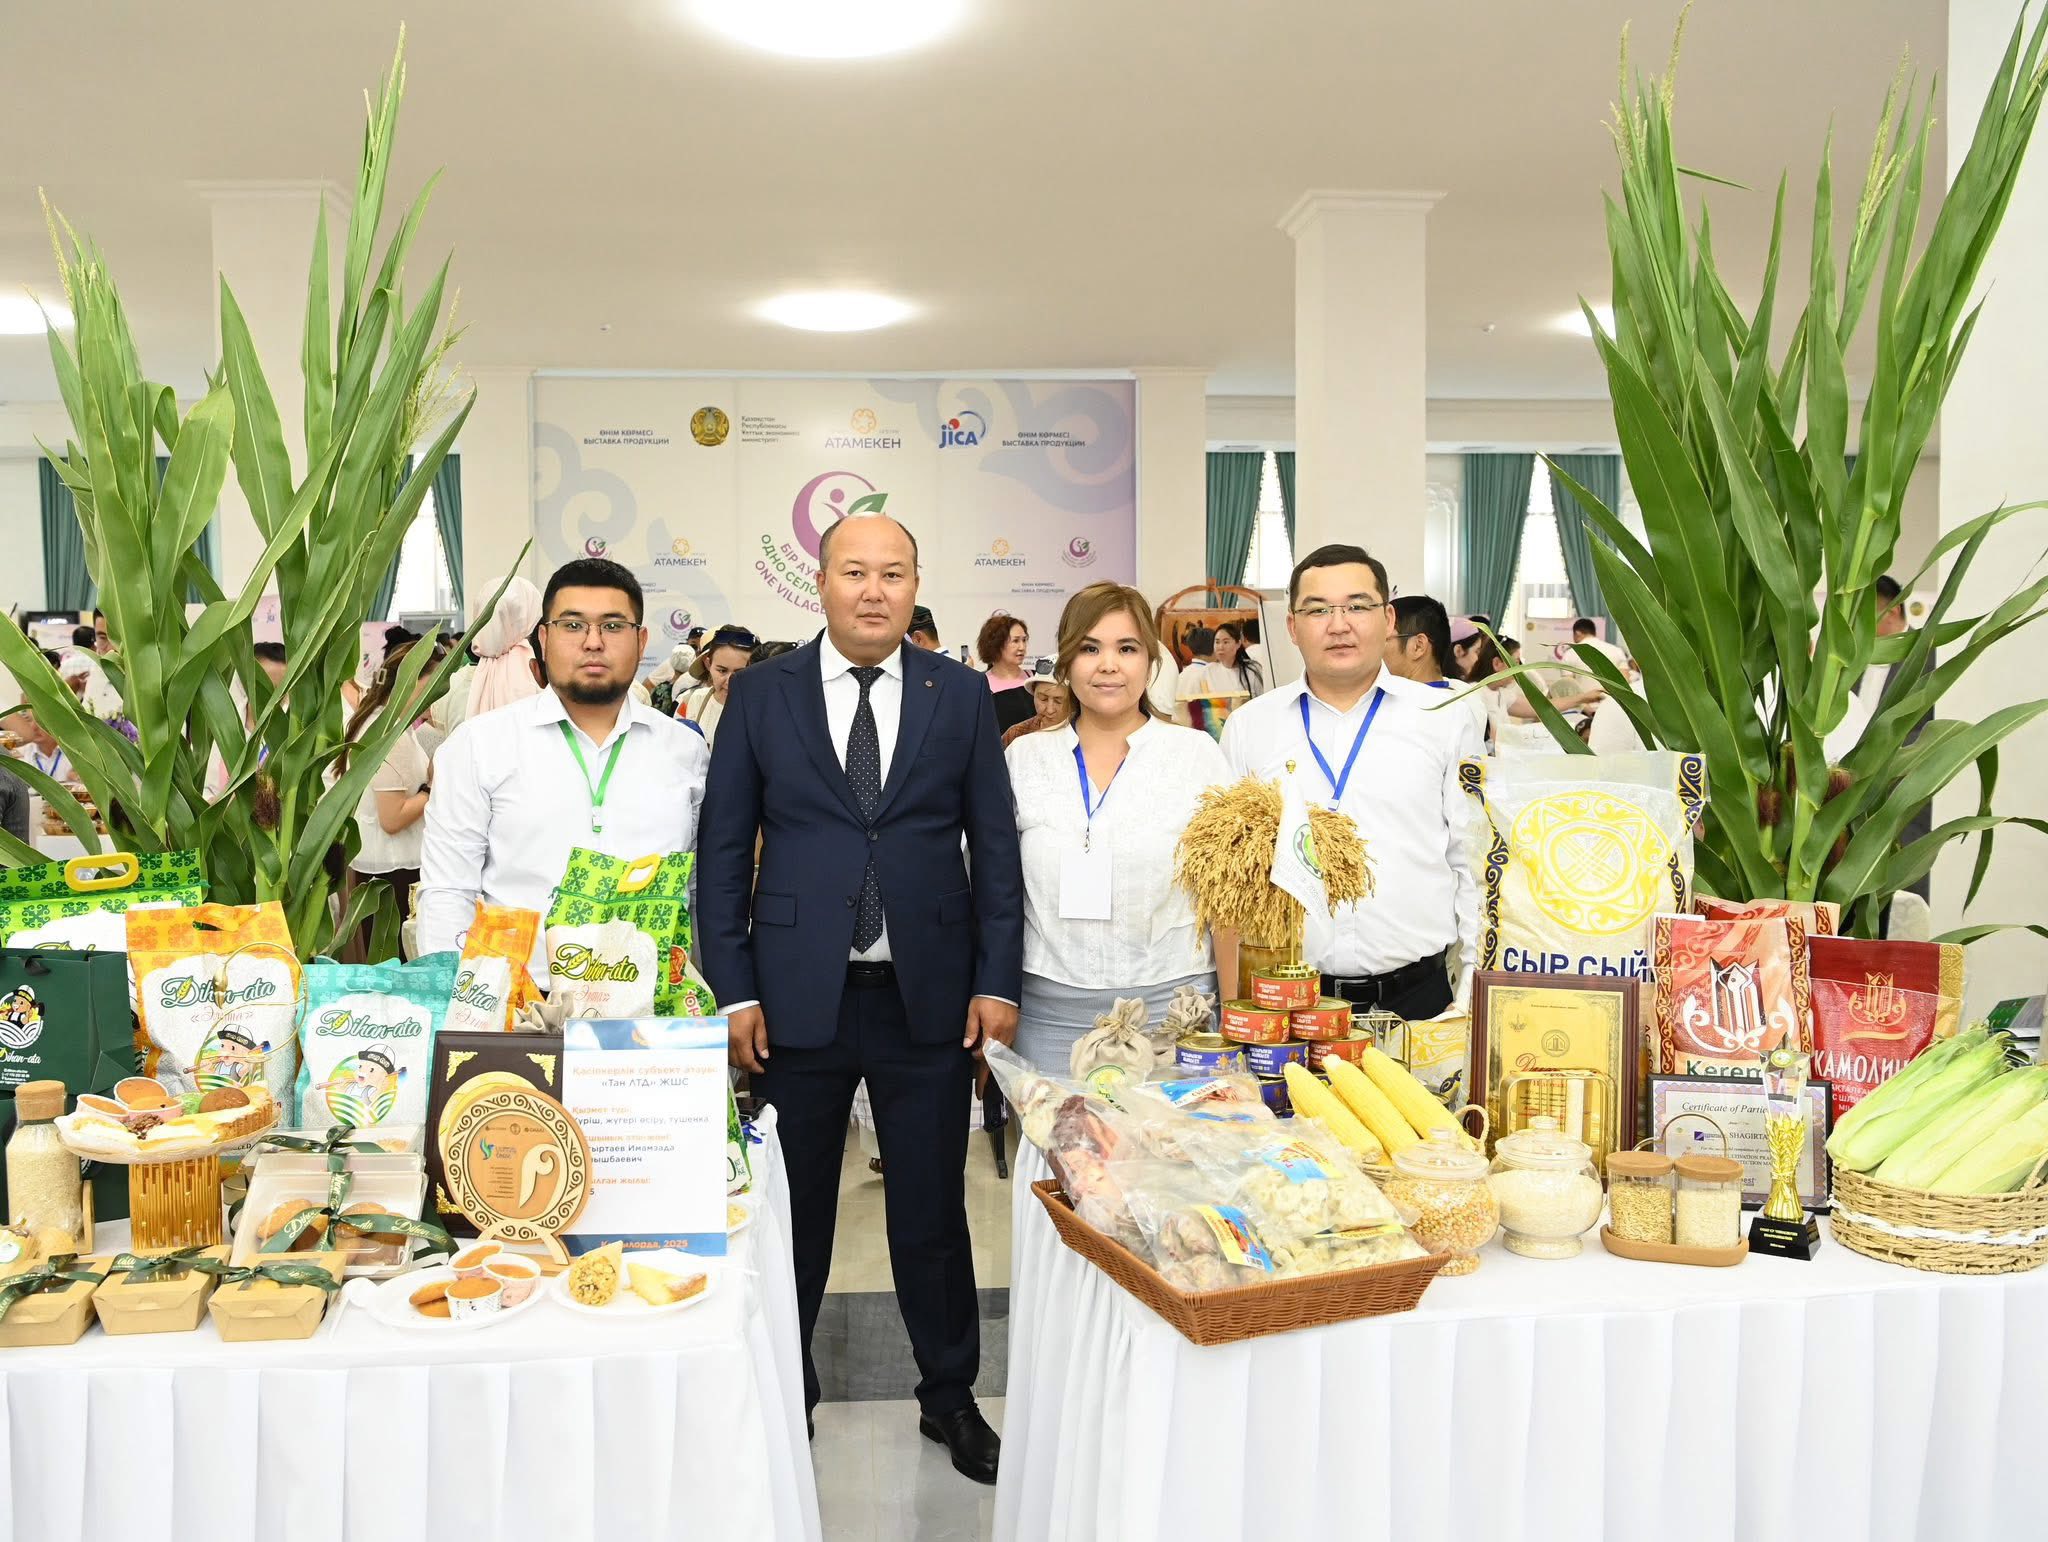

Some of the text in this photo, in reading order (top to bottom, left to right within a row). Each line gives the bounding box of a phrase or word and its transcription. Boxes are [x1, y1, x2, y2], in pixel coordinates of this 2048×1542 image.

[825, 437, 901, 449] АТАМЕКЕН
[1040, 440, 1087, 448] ПРОДУКЦИИ
[654, 558, 707, 567] АТАМЕКЕН
[761, 534, 819, 596] ОДНО СЕЛО
[780, 543, 817, 580] БІР АУ
[974, 558, 1026, 567] АТАМЕКЕН
[755, 560, 778, 588] ONE
[1503, 947, 1570, 974] СЫР
[160, 975, 276, 1008] Dihn-ata
[316, 1009, 423, 1041] Dihan-ata
[659, 1078, 689, 1087] ЖШС
[1682, 1102, 1768, 1114] Certificate of Partic
[1729, 1131, 1769, 1140] SHAGIRTA
[628, 1144, 676, 1153] Имамзада
